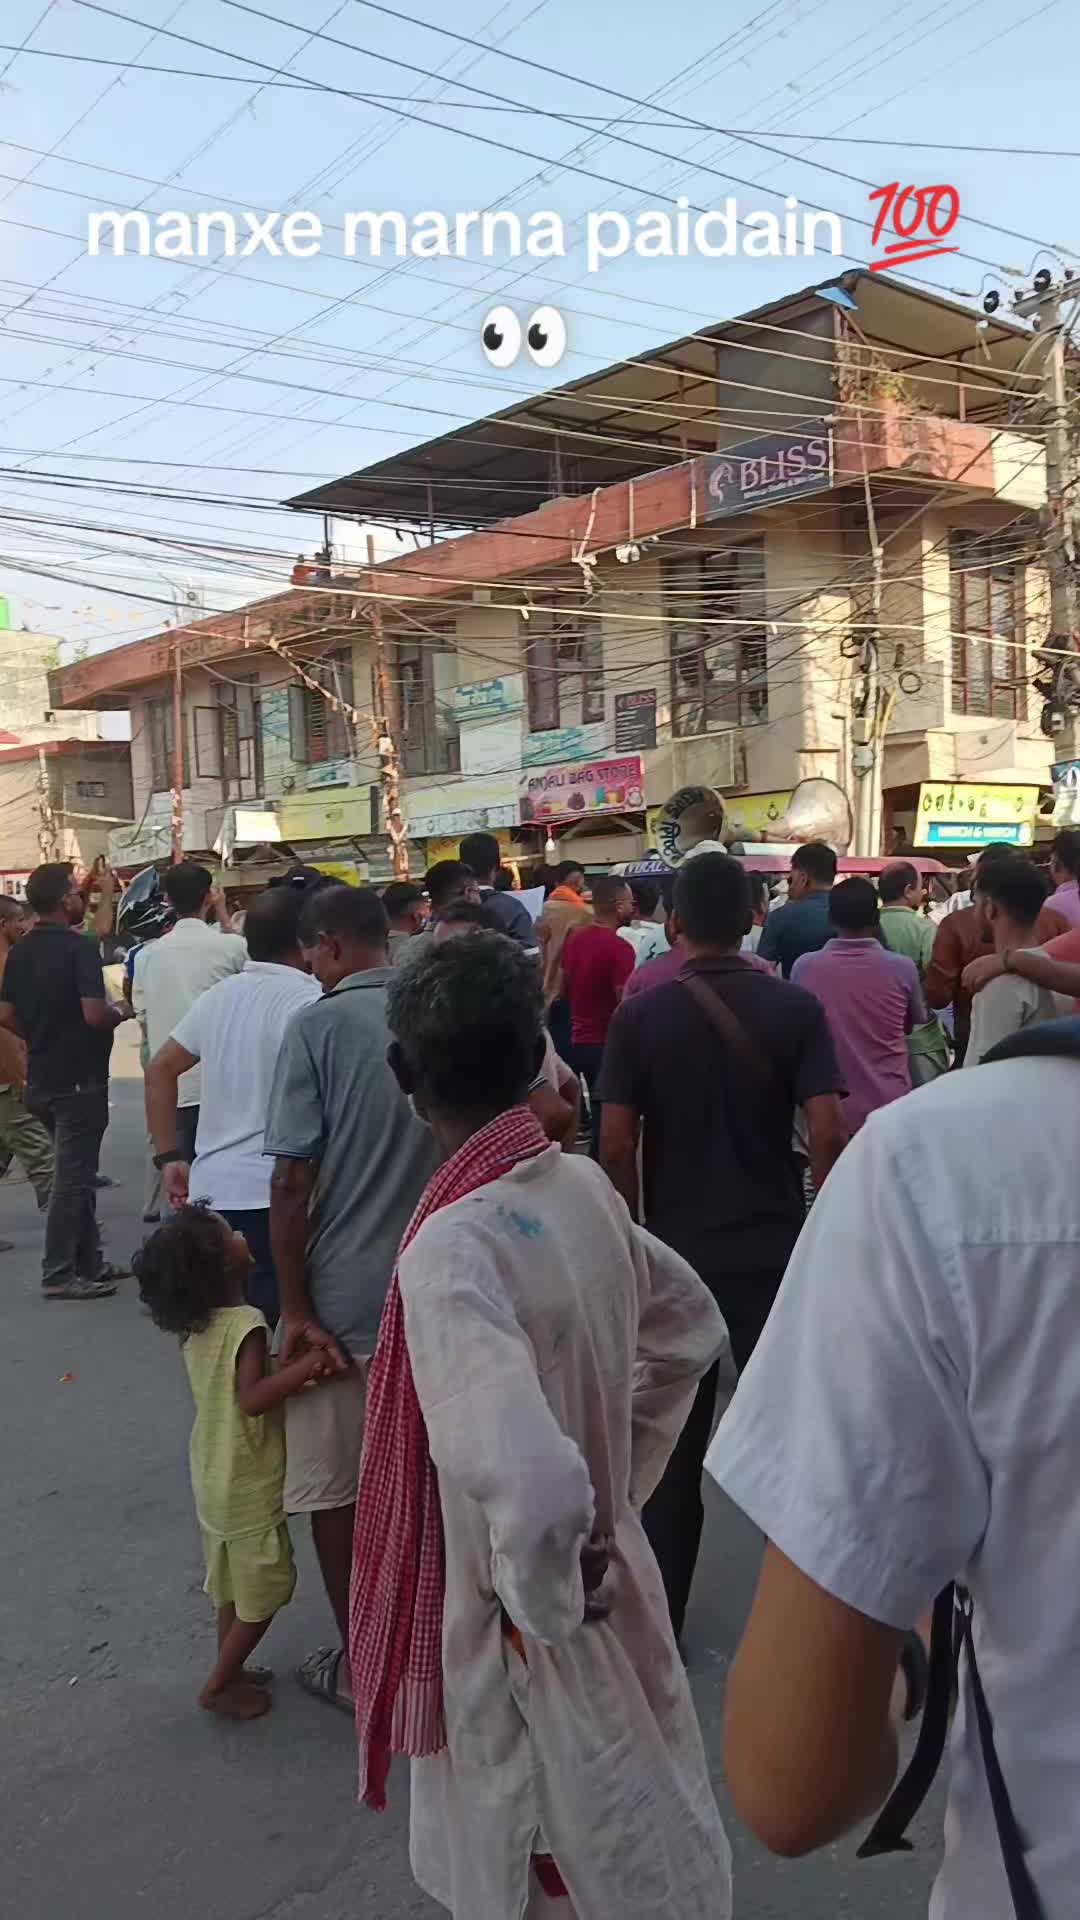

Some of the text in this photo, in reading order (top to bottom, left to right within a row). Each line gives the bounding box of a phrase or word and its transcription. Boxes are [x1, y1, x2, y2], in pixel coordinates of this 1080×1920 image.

[740, 439, 827, 491] BLISS
[568, 769, 594, 785] BAG
[597, 763, 636, 782] STORE
